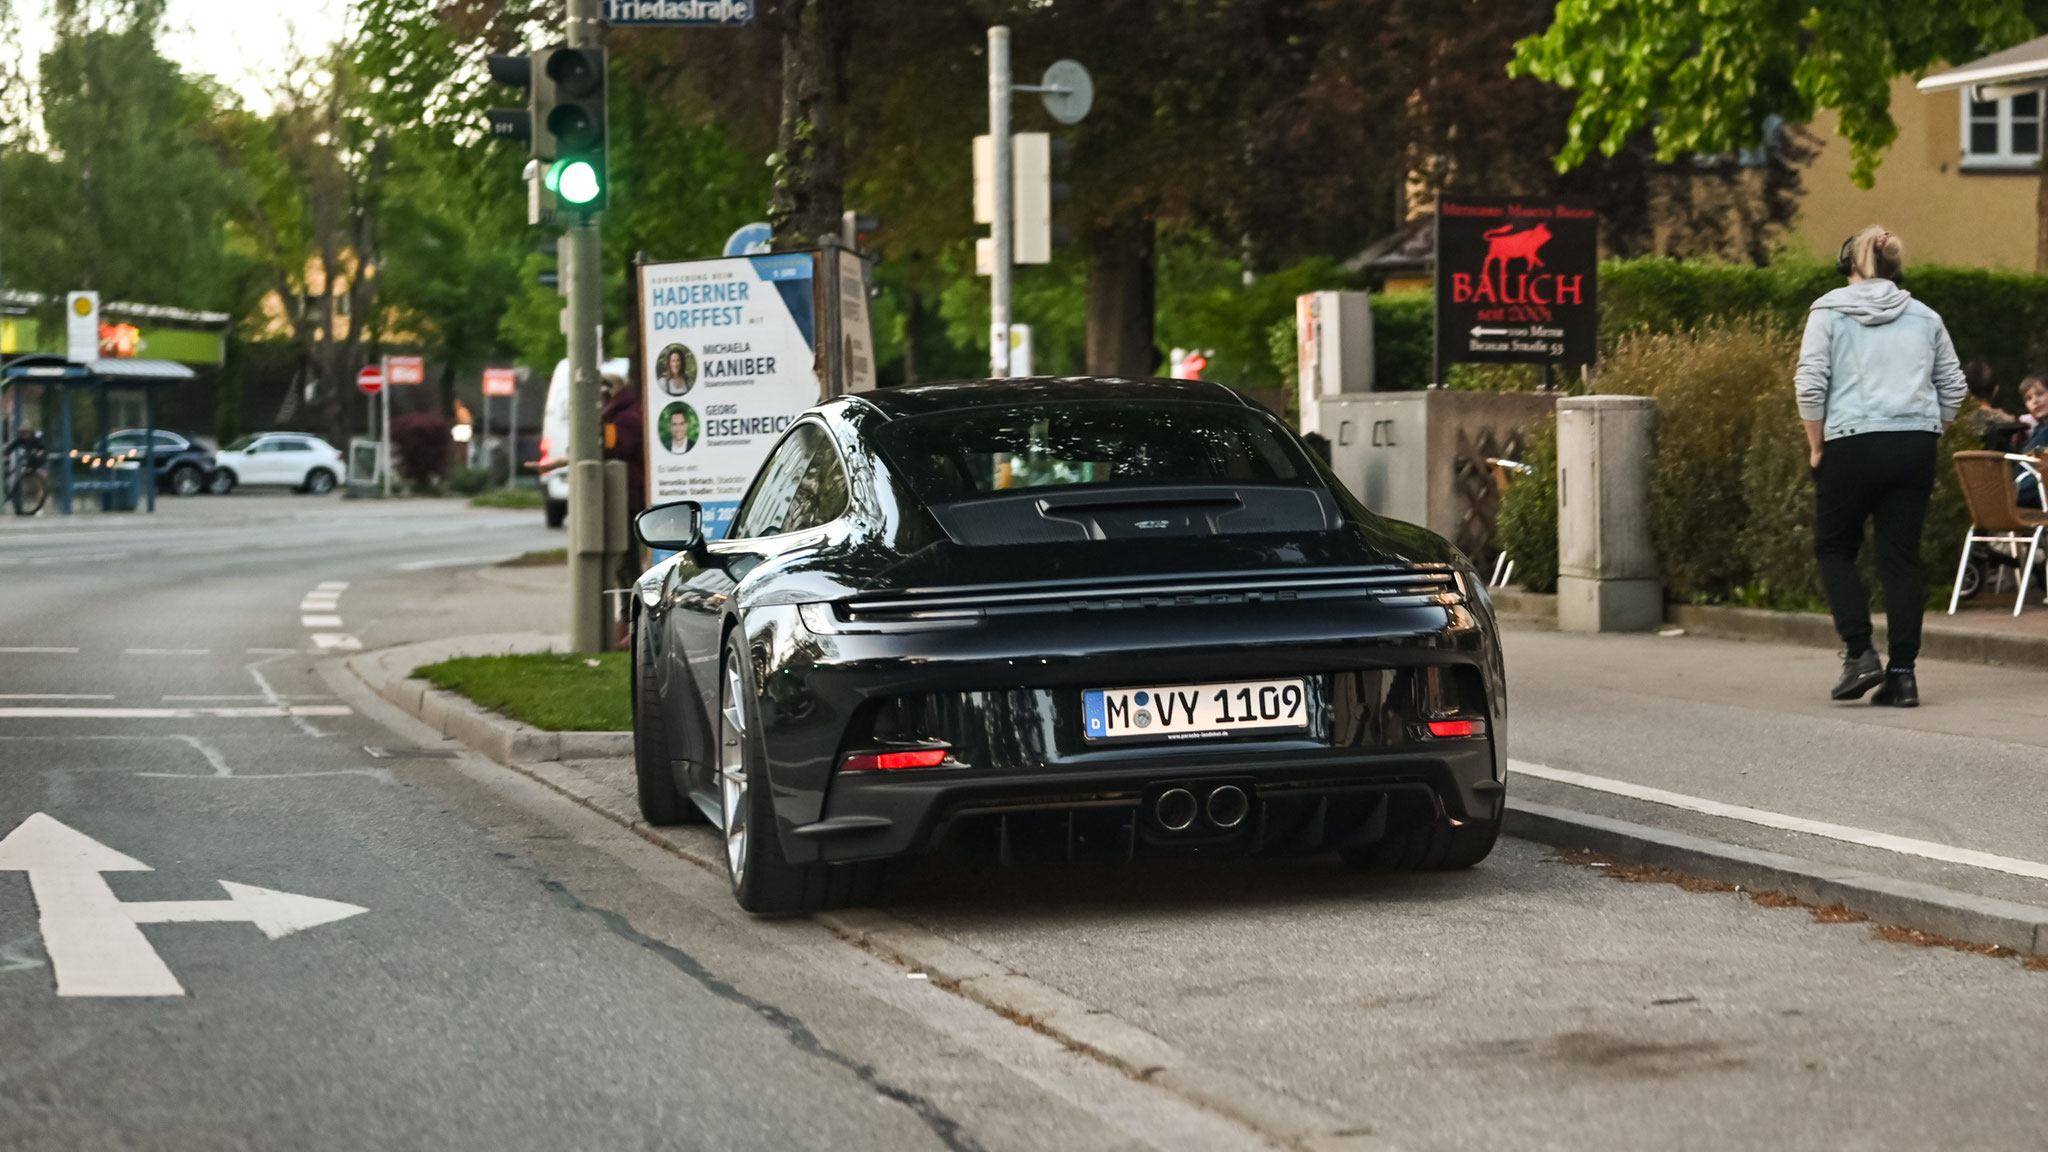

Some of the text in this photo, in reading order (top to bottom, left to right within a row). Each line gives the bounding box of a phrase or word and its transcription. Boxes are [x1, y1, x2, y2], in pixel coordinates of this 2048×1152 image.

[653, 281, 749, 307] HADERNER
[1452, 272, 1584, 305] BAUCH
[654, 305, 743, 331] DORFFEST
[703, 342, 751, 355] MICHAELA
[704, 357, 776, 378] KANIBER
[705, 404, 737, 416] GEORG
[1106, 684, 1302, 729] M VY 1109
[1091, 718, 1101, 730] D
